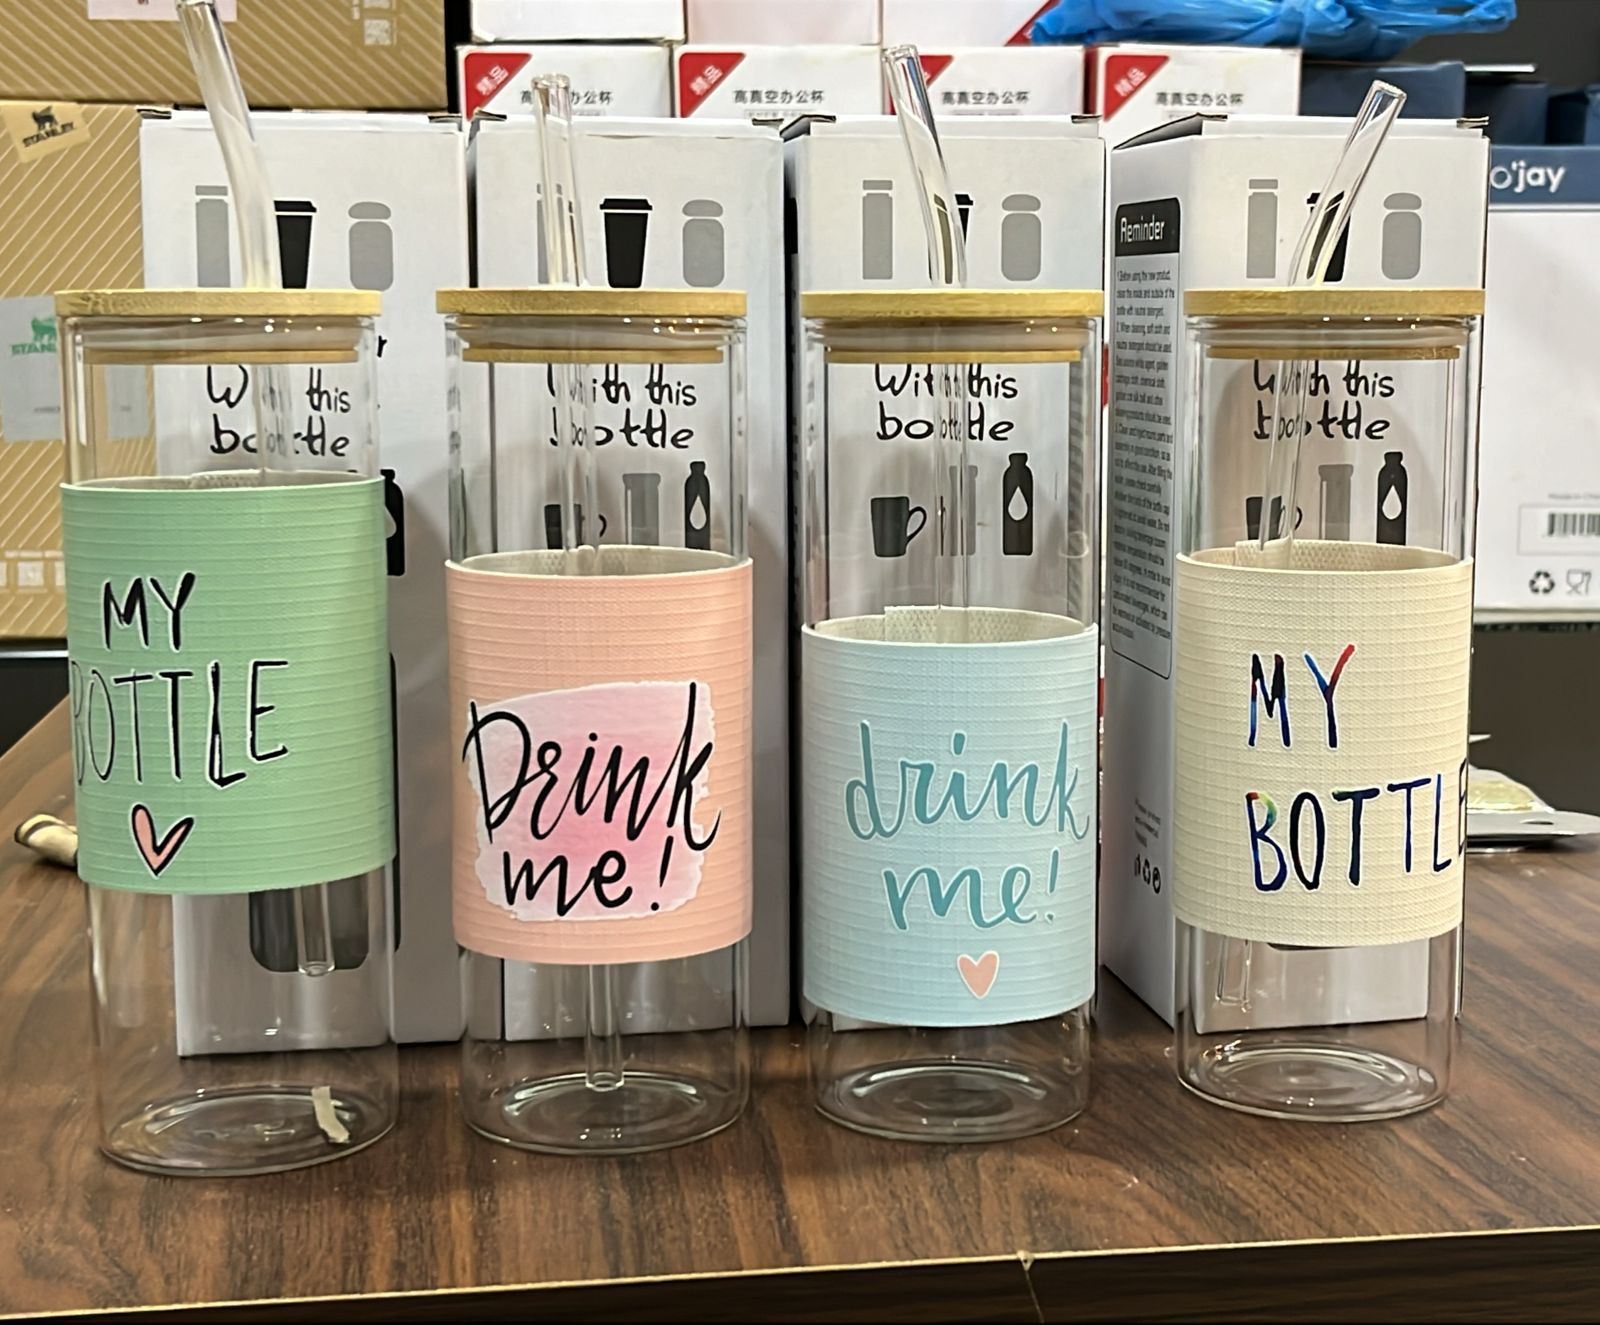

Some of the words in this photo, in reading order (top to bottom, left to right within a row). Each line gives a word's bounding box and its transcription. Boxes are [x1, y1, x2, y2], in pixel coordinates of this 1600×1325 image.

[733, 89, 825, 105] 高真空办公杯
[941, 90, 1031, 106] 高真空办公杯
[1155, 91, 1245, 107] 高真空办公杯
[1120, 214, 1166, 243] Reminder
[11, 343, 57, 356] STAN
[305, 367, 351, 413] this
[645, 363, 697, 407] this
[1343, 360, 1395, 397] this
[103, 572, 195, 650] MY
[1248, 644, 1355, 749] MY
[70, 660, 288, 788] BOTTLE
[462, 682, 722, 851] Drink
[846, 718, 1090, 840] drink
[503, 835, 675, 917] me!
[884, 849, 1060, 931] me!
